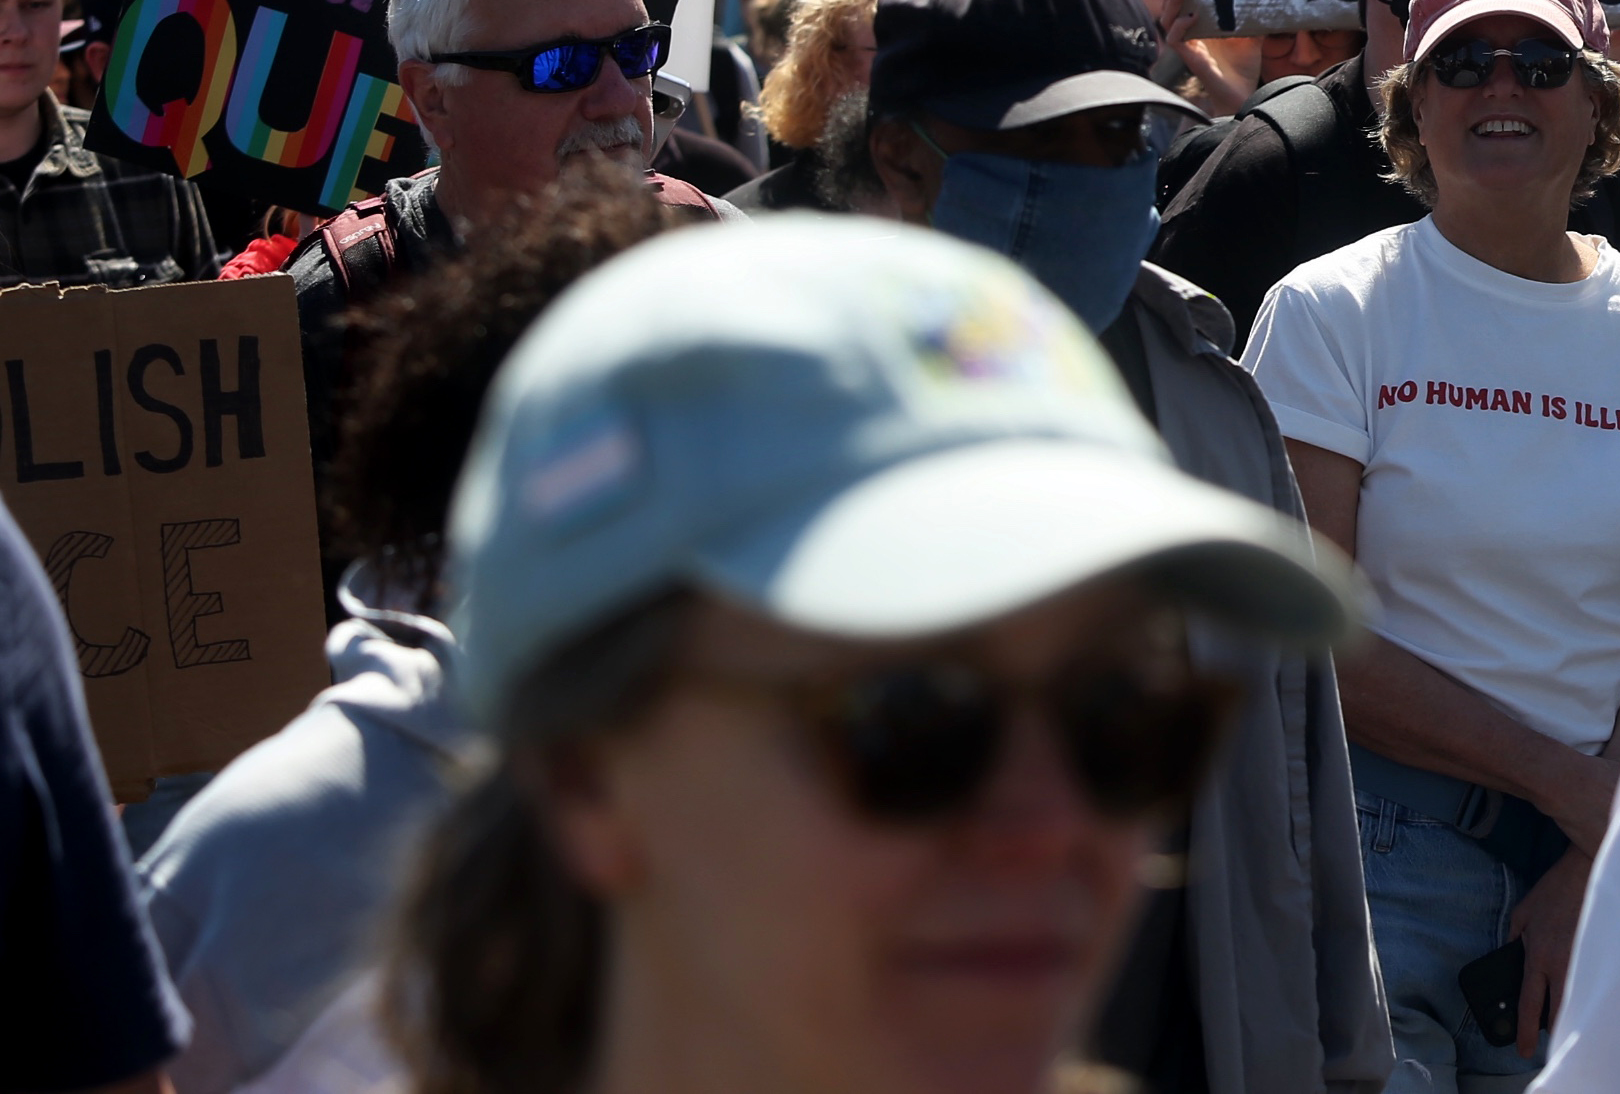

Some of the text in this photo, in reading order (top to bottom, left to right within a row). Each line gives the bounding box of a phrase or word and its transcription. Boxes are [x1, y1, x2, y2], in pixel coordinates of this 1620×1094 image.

[3, 335, 266, 484] LISH
[1377, 380, 1418, 410] NO
[1425, 380, 1532, 415] HUMAN
[1541, 394, 1567, 420] IS
[45, 518, 253, 679] CE
